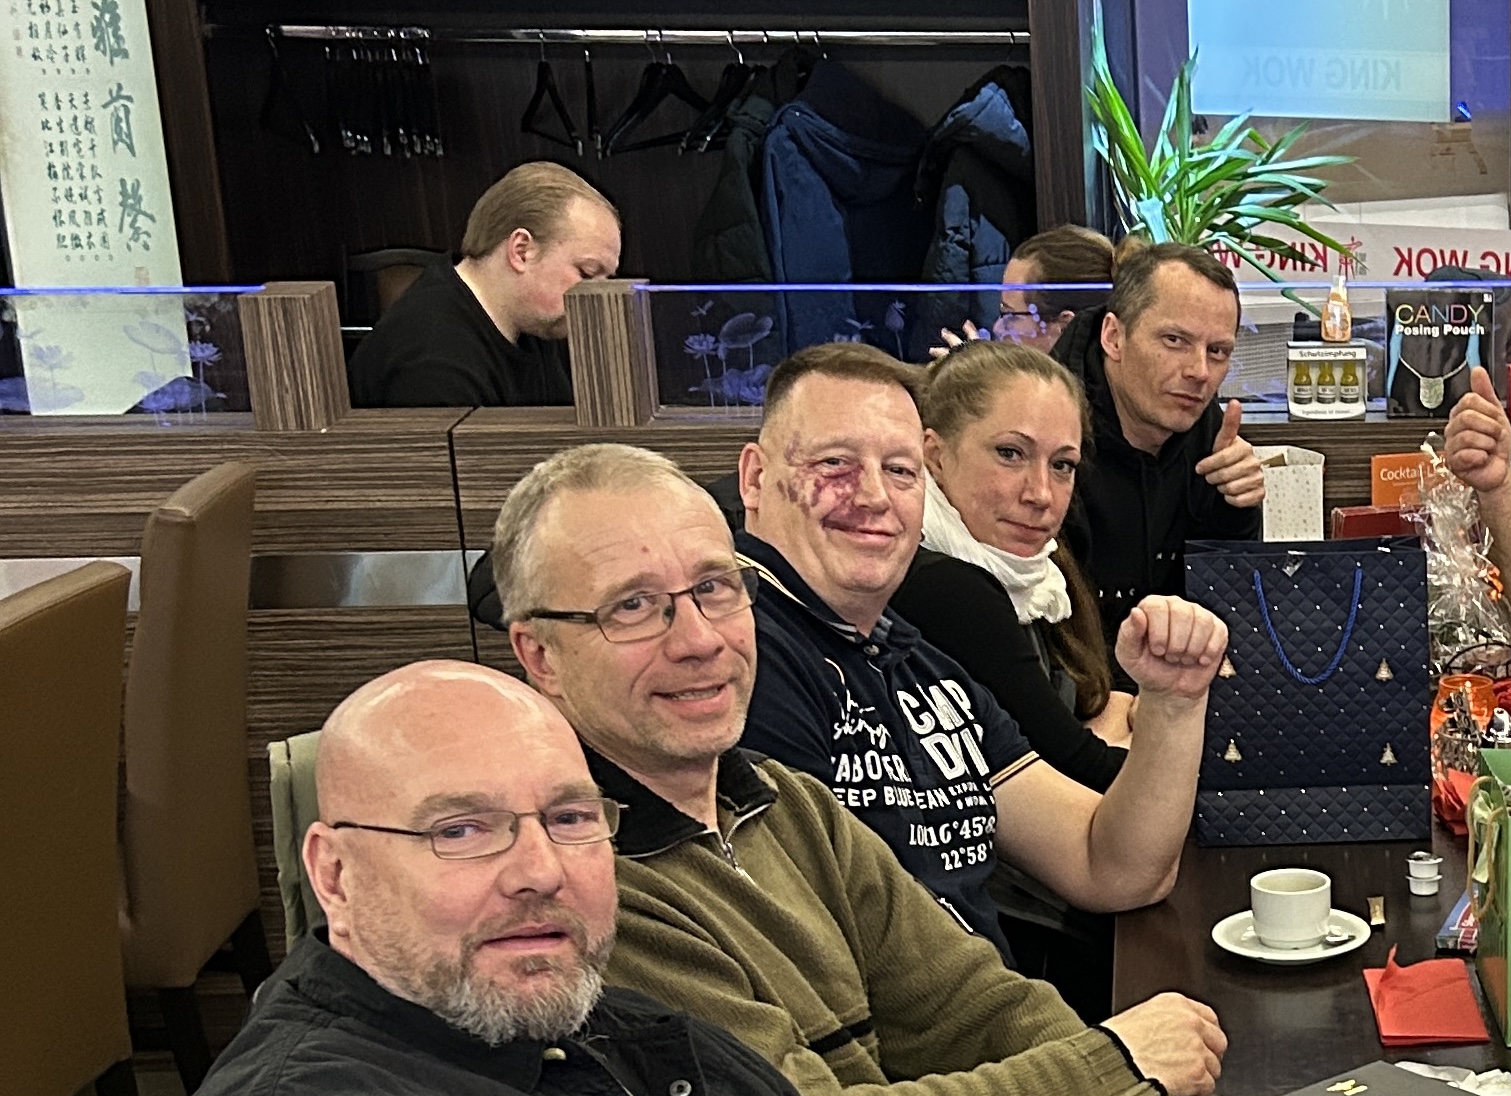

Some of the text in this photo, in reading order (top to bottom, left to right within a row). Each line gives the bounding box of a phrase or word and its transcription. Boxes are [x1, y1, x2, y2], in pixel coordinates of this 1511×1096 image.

[1395, 304, 1485, 324] CANDY
[1395, 324, 1485, 337] Posing Pouch
